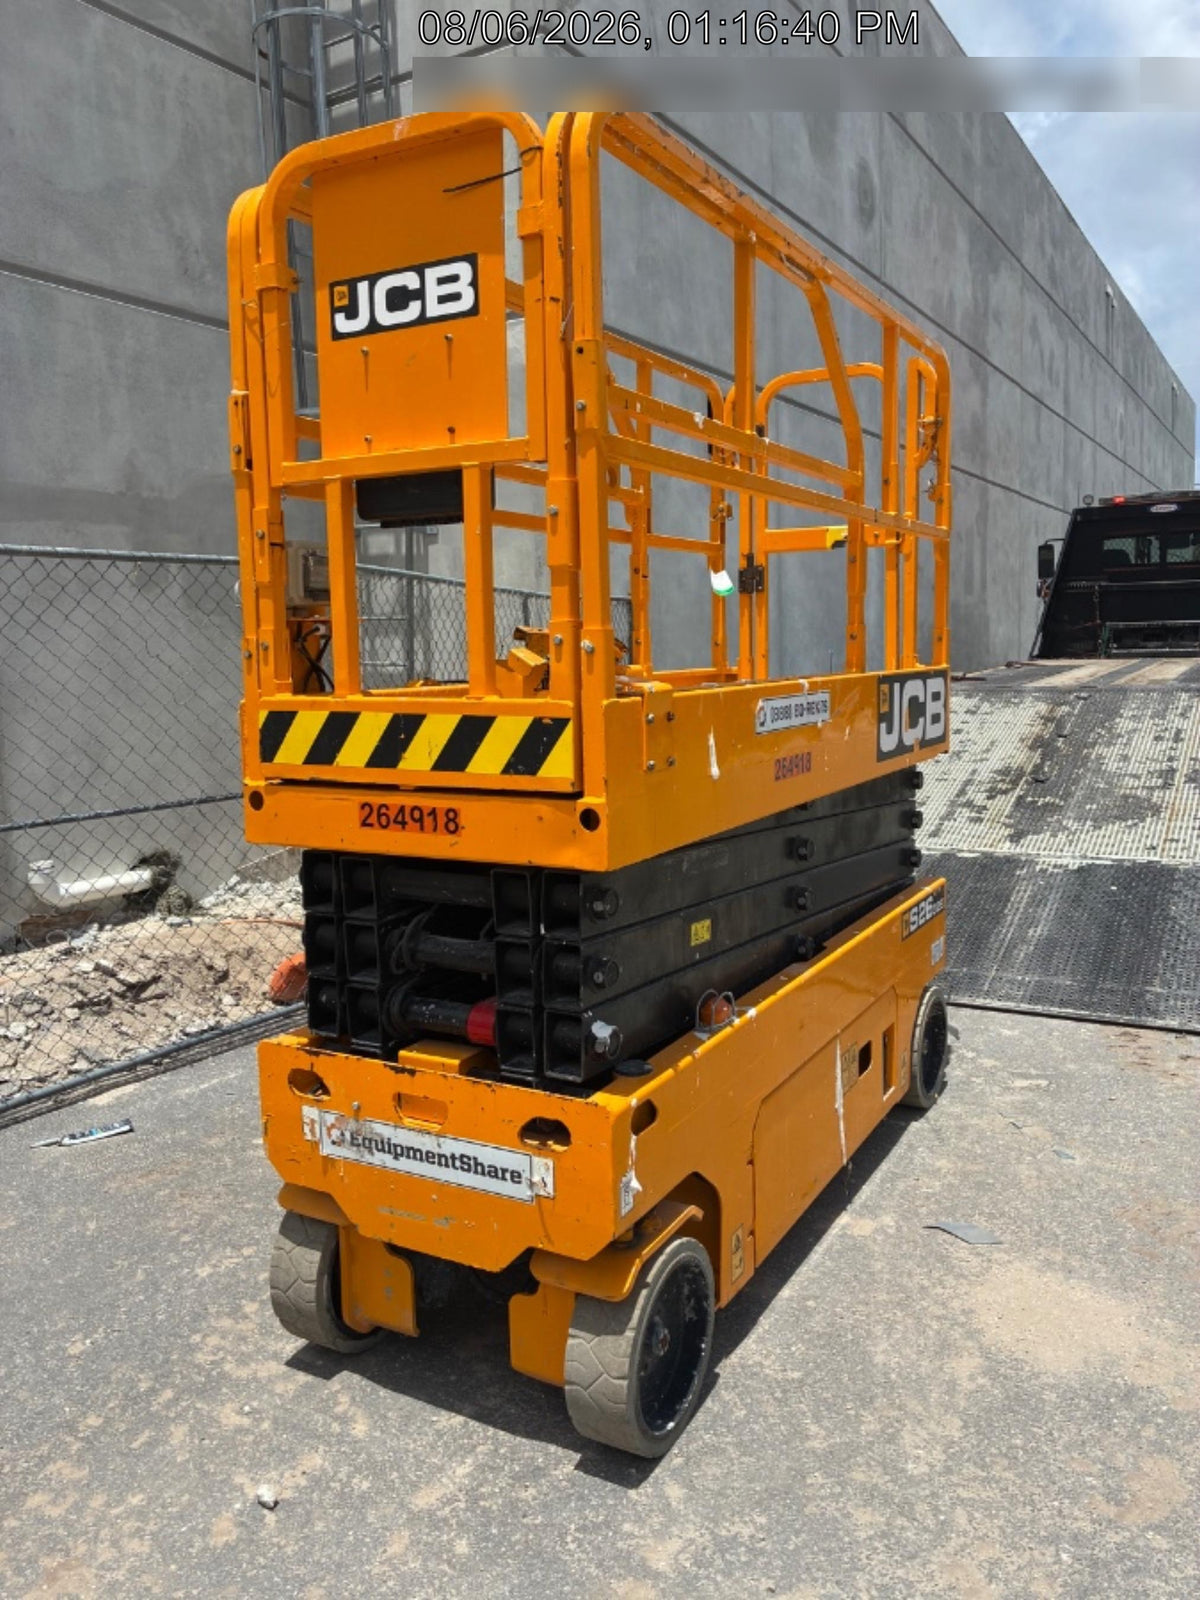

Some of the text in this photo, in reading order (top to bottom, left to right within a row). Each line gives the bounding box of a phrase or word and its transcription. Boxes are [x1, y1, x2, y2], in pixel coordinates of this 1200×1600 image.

[334, 261, 476, 333] JCB
[880, 677, 946, 753] JCB
[774, 752, 812, 781] 264918
[360, 802, 459, 834] 264918
[350, 1133, 523, 1184] EquipmentShare
